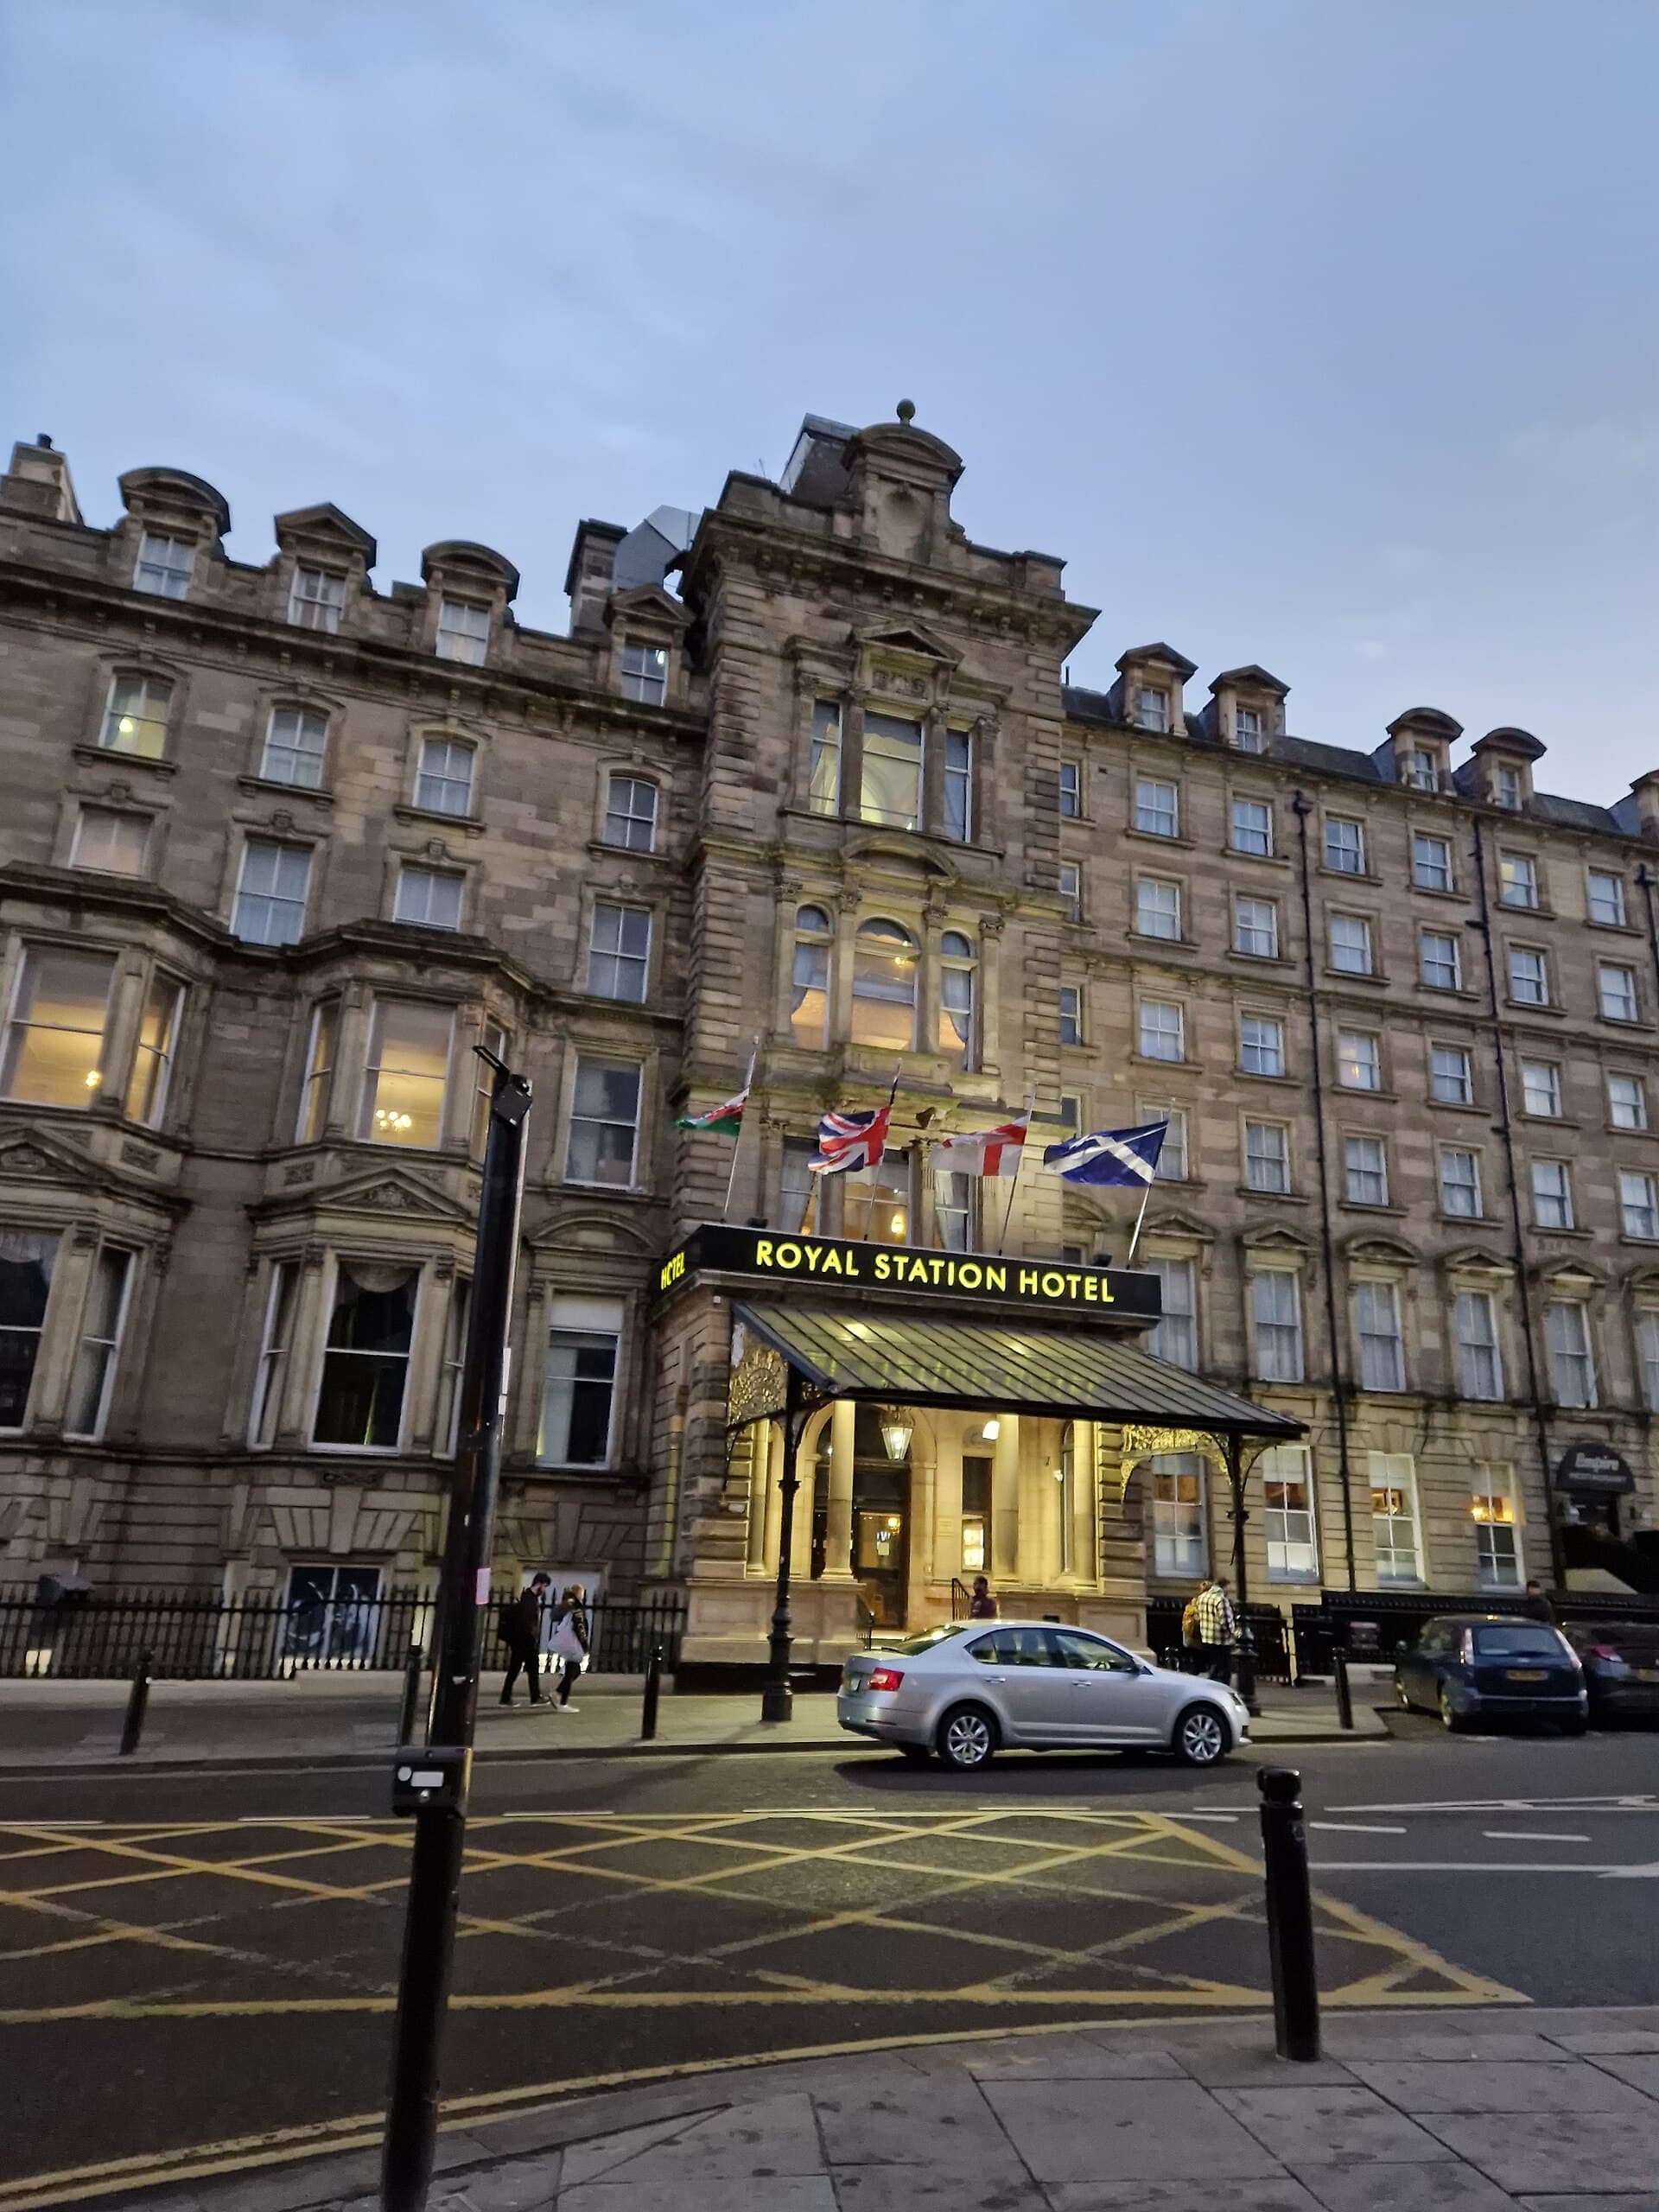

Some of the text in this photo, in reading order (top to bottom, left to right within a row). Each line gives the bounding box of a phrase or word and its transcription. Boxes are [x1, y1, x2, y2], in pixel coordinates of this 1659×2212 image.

[660, 1251, 685, 1291] HOTEL
[756, 1239, 1115, 1302] ROYAL STATION HOTEL
